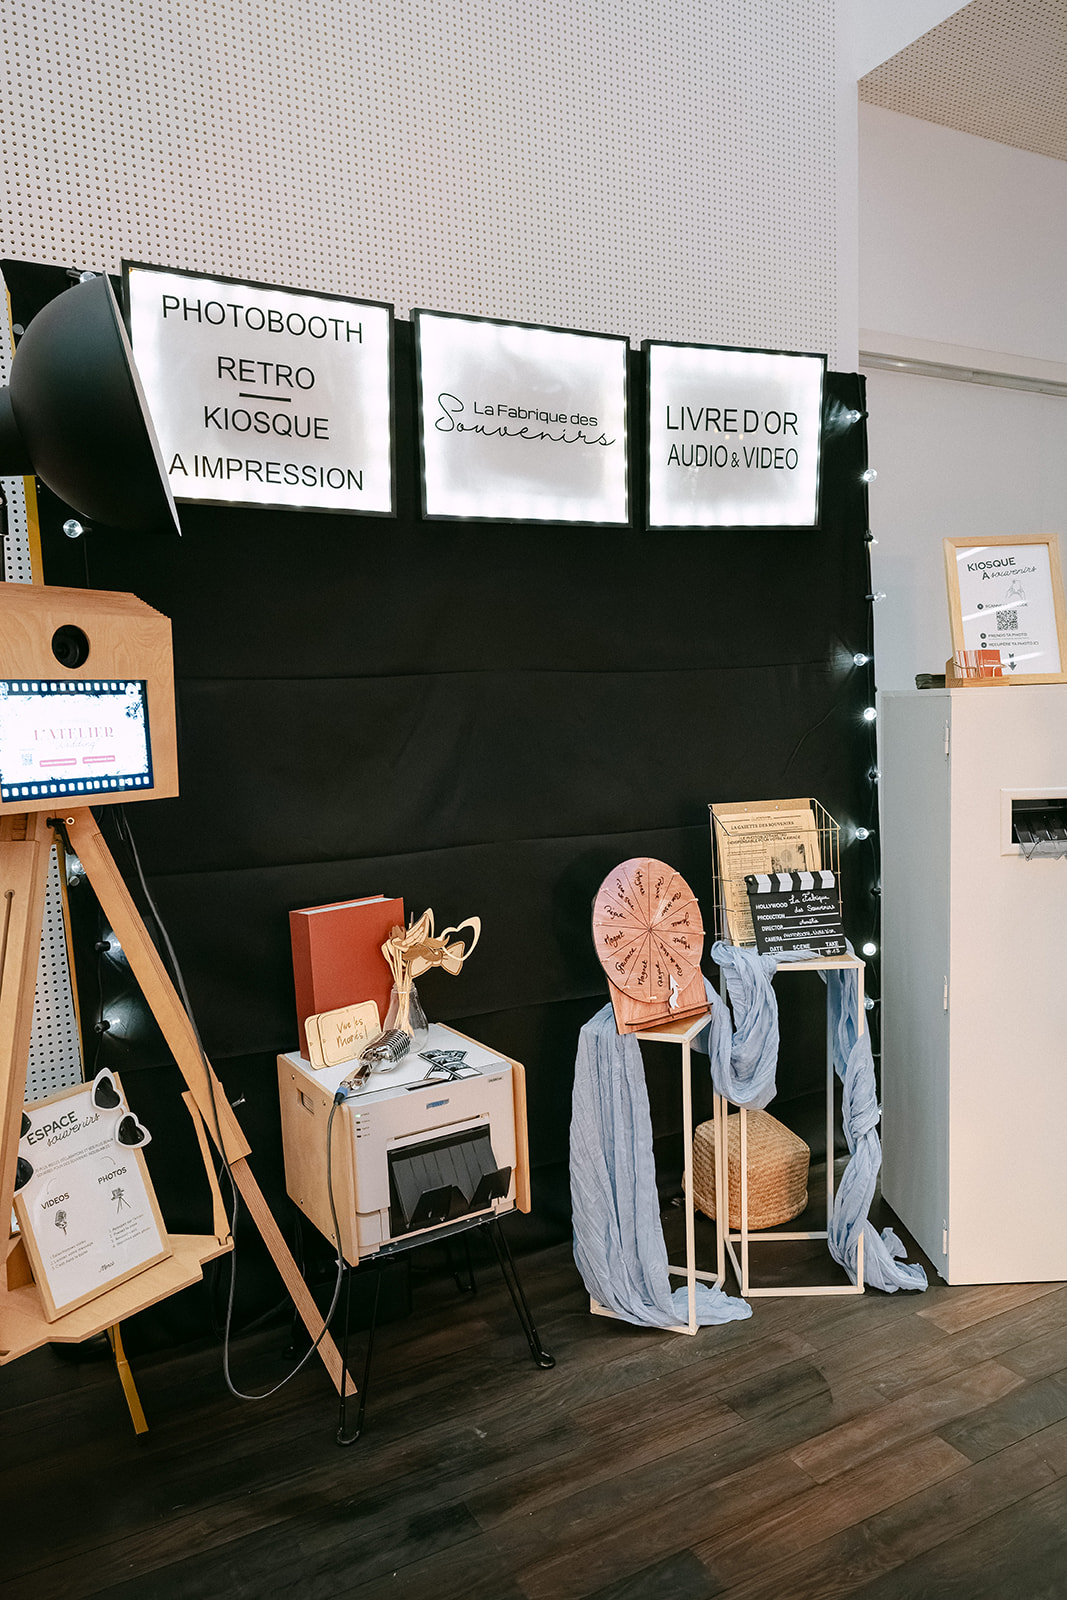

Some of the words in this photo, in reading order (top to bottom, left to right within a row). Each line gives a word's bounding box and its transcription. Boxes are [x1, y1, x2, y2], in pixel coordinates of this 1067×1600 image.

[162, 294, 363, 344] PHOTOBOOTH
[217, 356, 315, 390] RETRO
[204, 405, 330, 440] KIOSQUE
[434, 392, 616, 446] Souvenirs
[473, 401, 494, 416] La
[497, 404, 568, 427] Fabrique
[569, 412, 598, 427] des
[666, 405, 738, 433] LIVRE
[168, 453, 189, 477] A
[194, 454, 363, 491] IMPRESSION
[667, 443, 728, 468] AUDIO
[730, 451, 740, 468] &
[743, 446, 799, 470] VIDEO
[967, 557, 1016, 572] KIOSQUE
[755, 902, 788, 910] HOLLYWOOD
[26, 1110, 78, 1146] ESPACE
[47, 1112, 101, 1147] souvenirs
[98, 1166, 127, 1185] PHOTOS
[41, 1192, 70, 1210] VIDEOS
